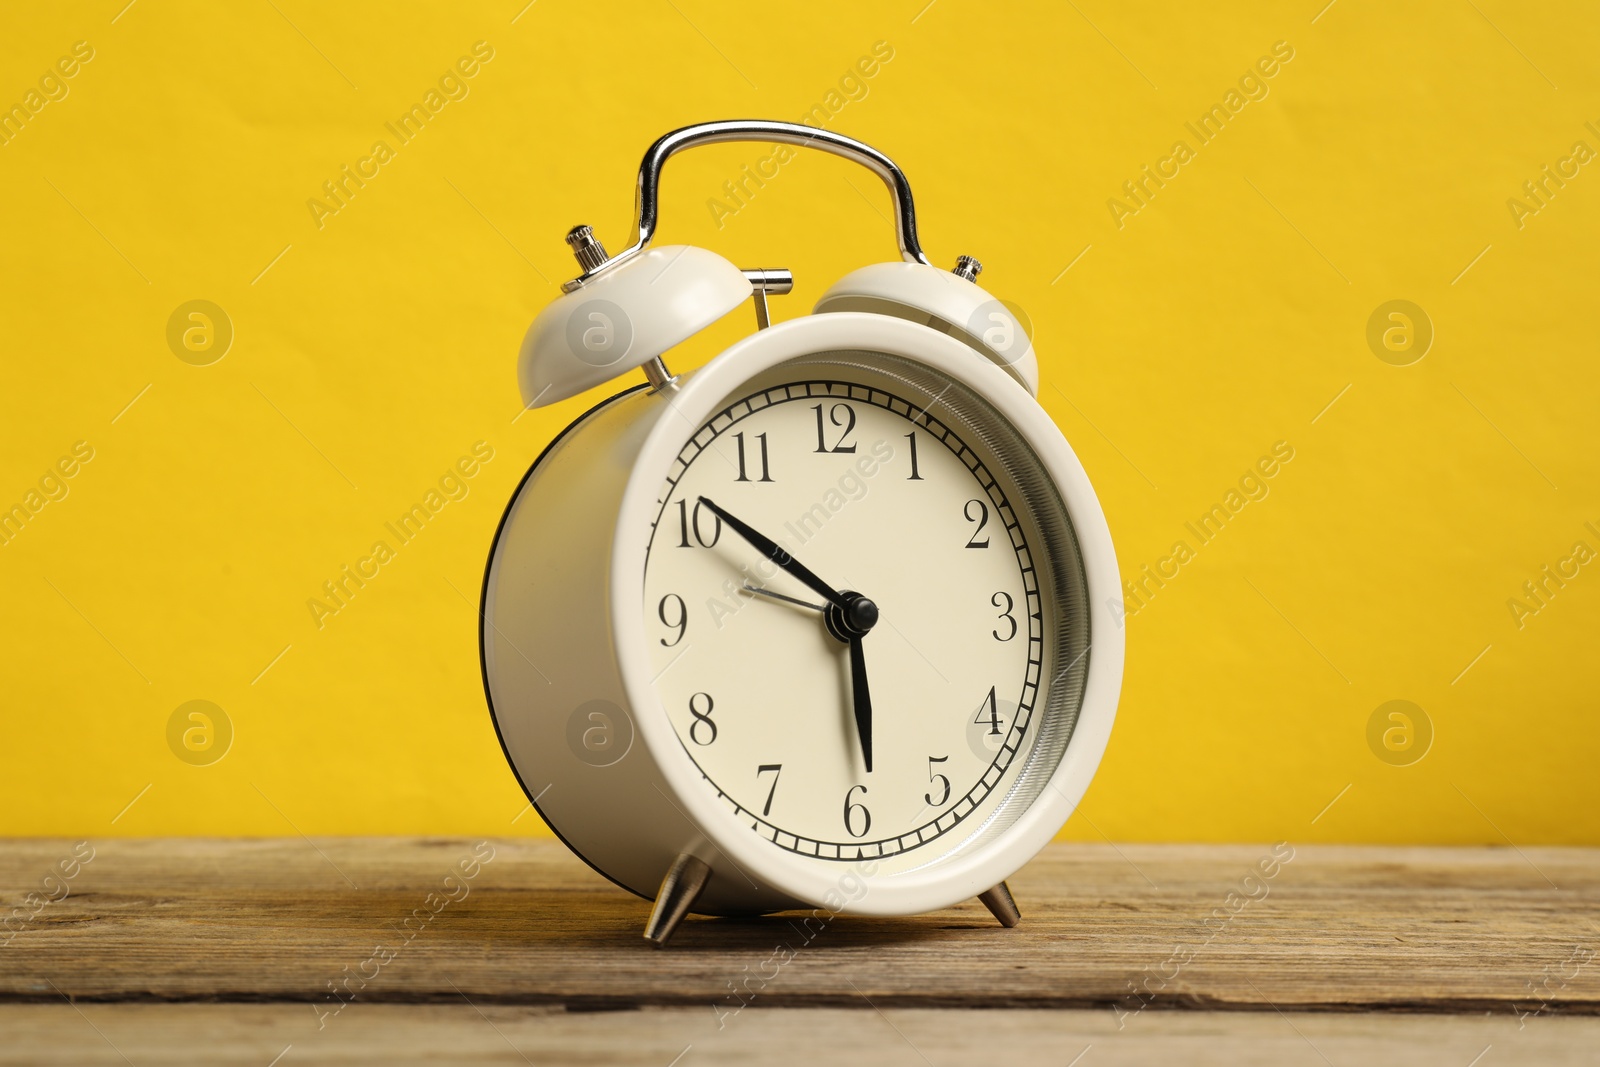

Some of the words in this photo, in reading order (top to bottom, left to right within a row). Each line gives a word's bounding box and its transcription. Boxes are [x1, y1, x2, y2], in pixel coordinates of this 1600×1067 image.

[810, 403, 857, 454] 12
[731, 431, 776, 482] 11
[904, 431, 924, 480] 1
[674, 498, 722, 548] 10
[964, 499, 990, 549] 2
[658, 593, 687, 647] 9
[991, 592, 1017, 641] 3
[689, 692, 717, 746] 8
[974, 685, 1003, 735] 4
[757, 764, 782, 816] 7
[925, 756, 951, 806] 5
[843, 785, 871, 838] 6
